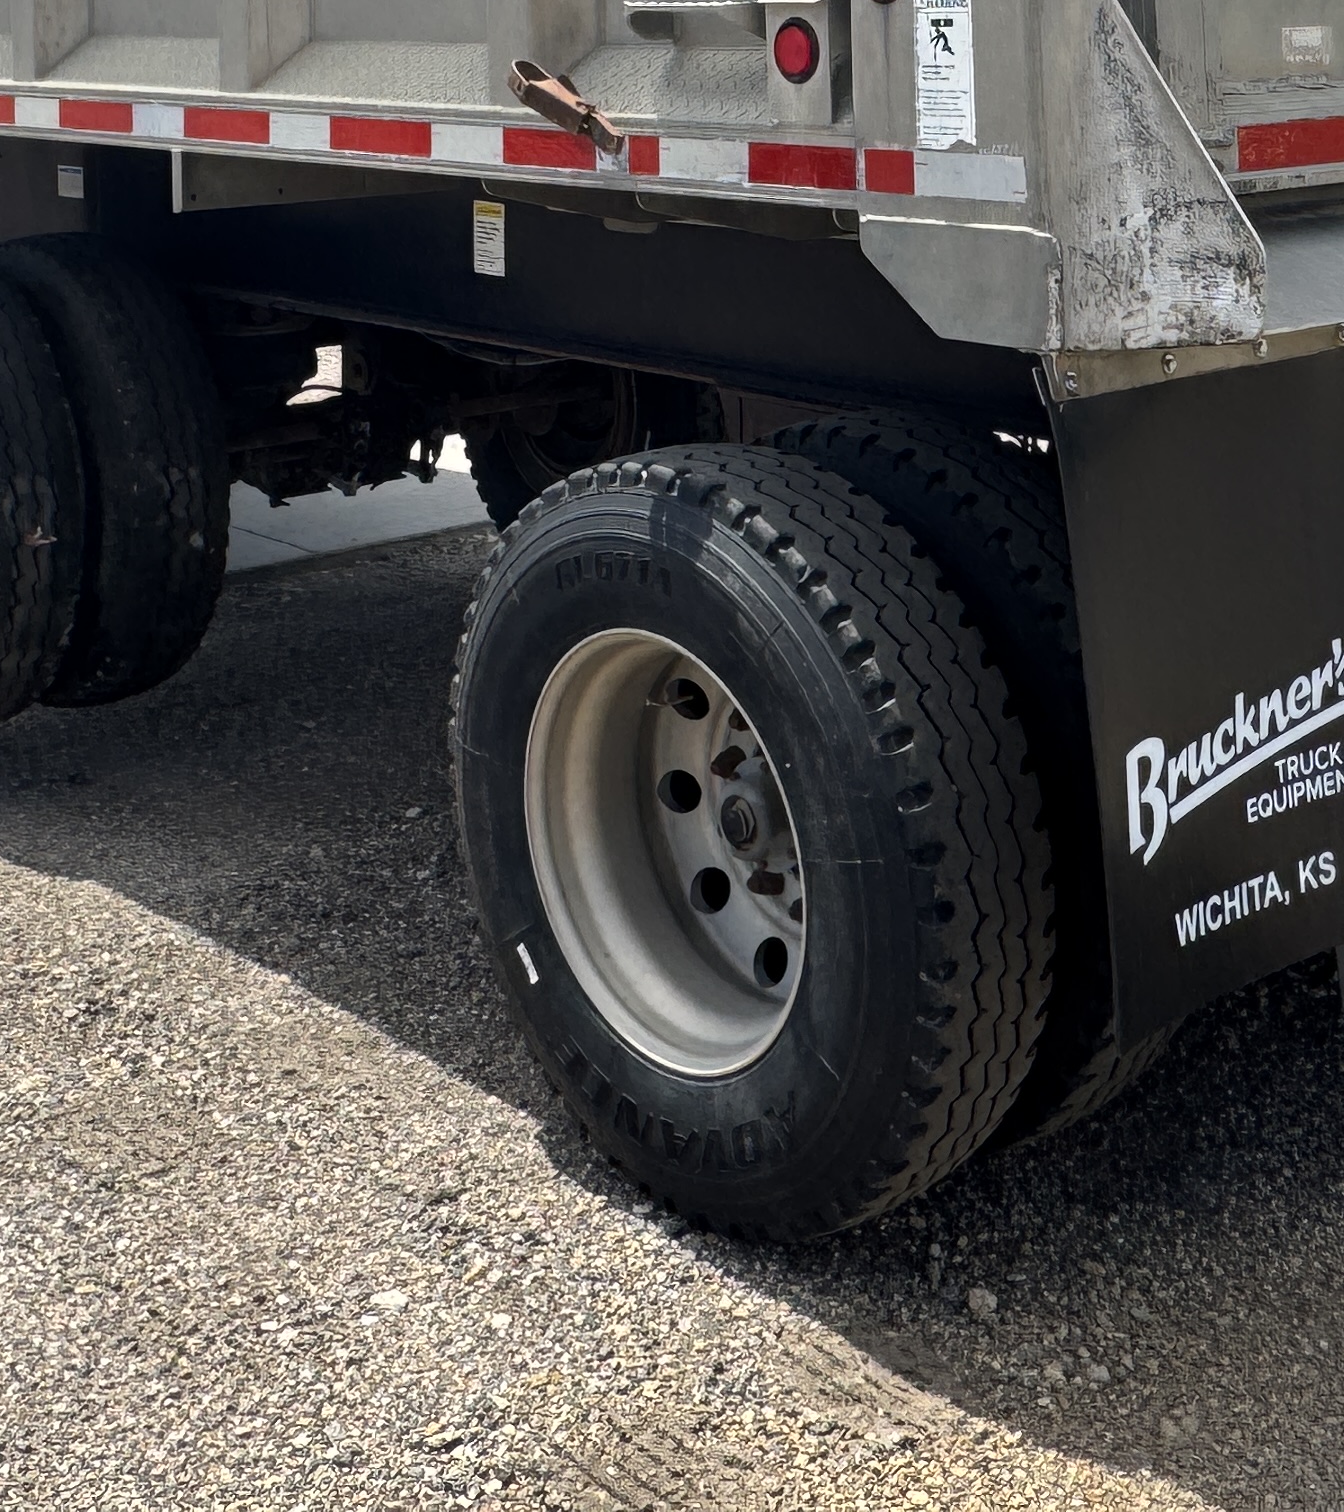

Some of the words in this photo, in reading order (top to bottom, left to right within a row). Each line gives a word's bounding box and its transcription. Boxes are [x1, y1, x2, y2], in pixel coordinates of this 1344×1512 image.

[1274, 745, 1343, 784] TRUCK
[1174, 871, 1291, 947] WICHITA,
[1298, 851, 1337, 895] KS
